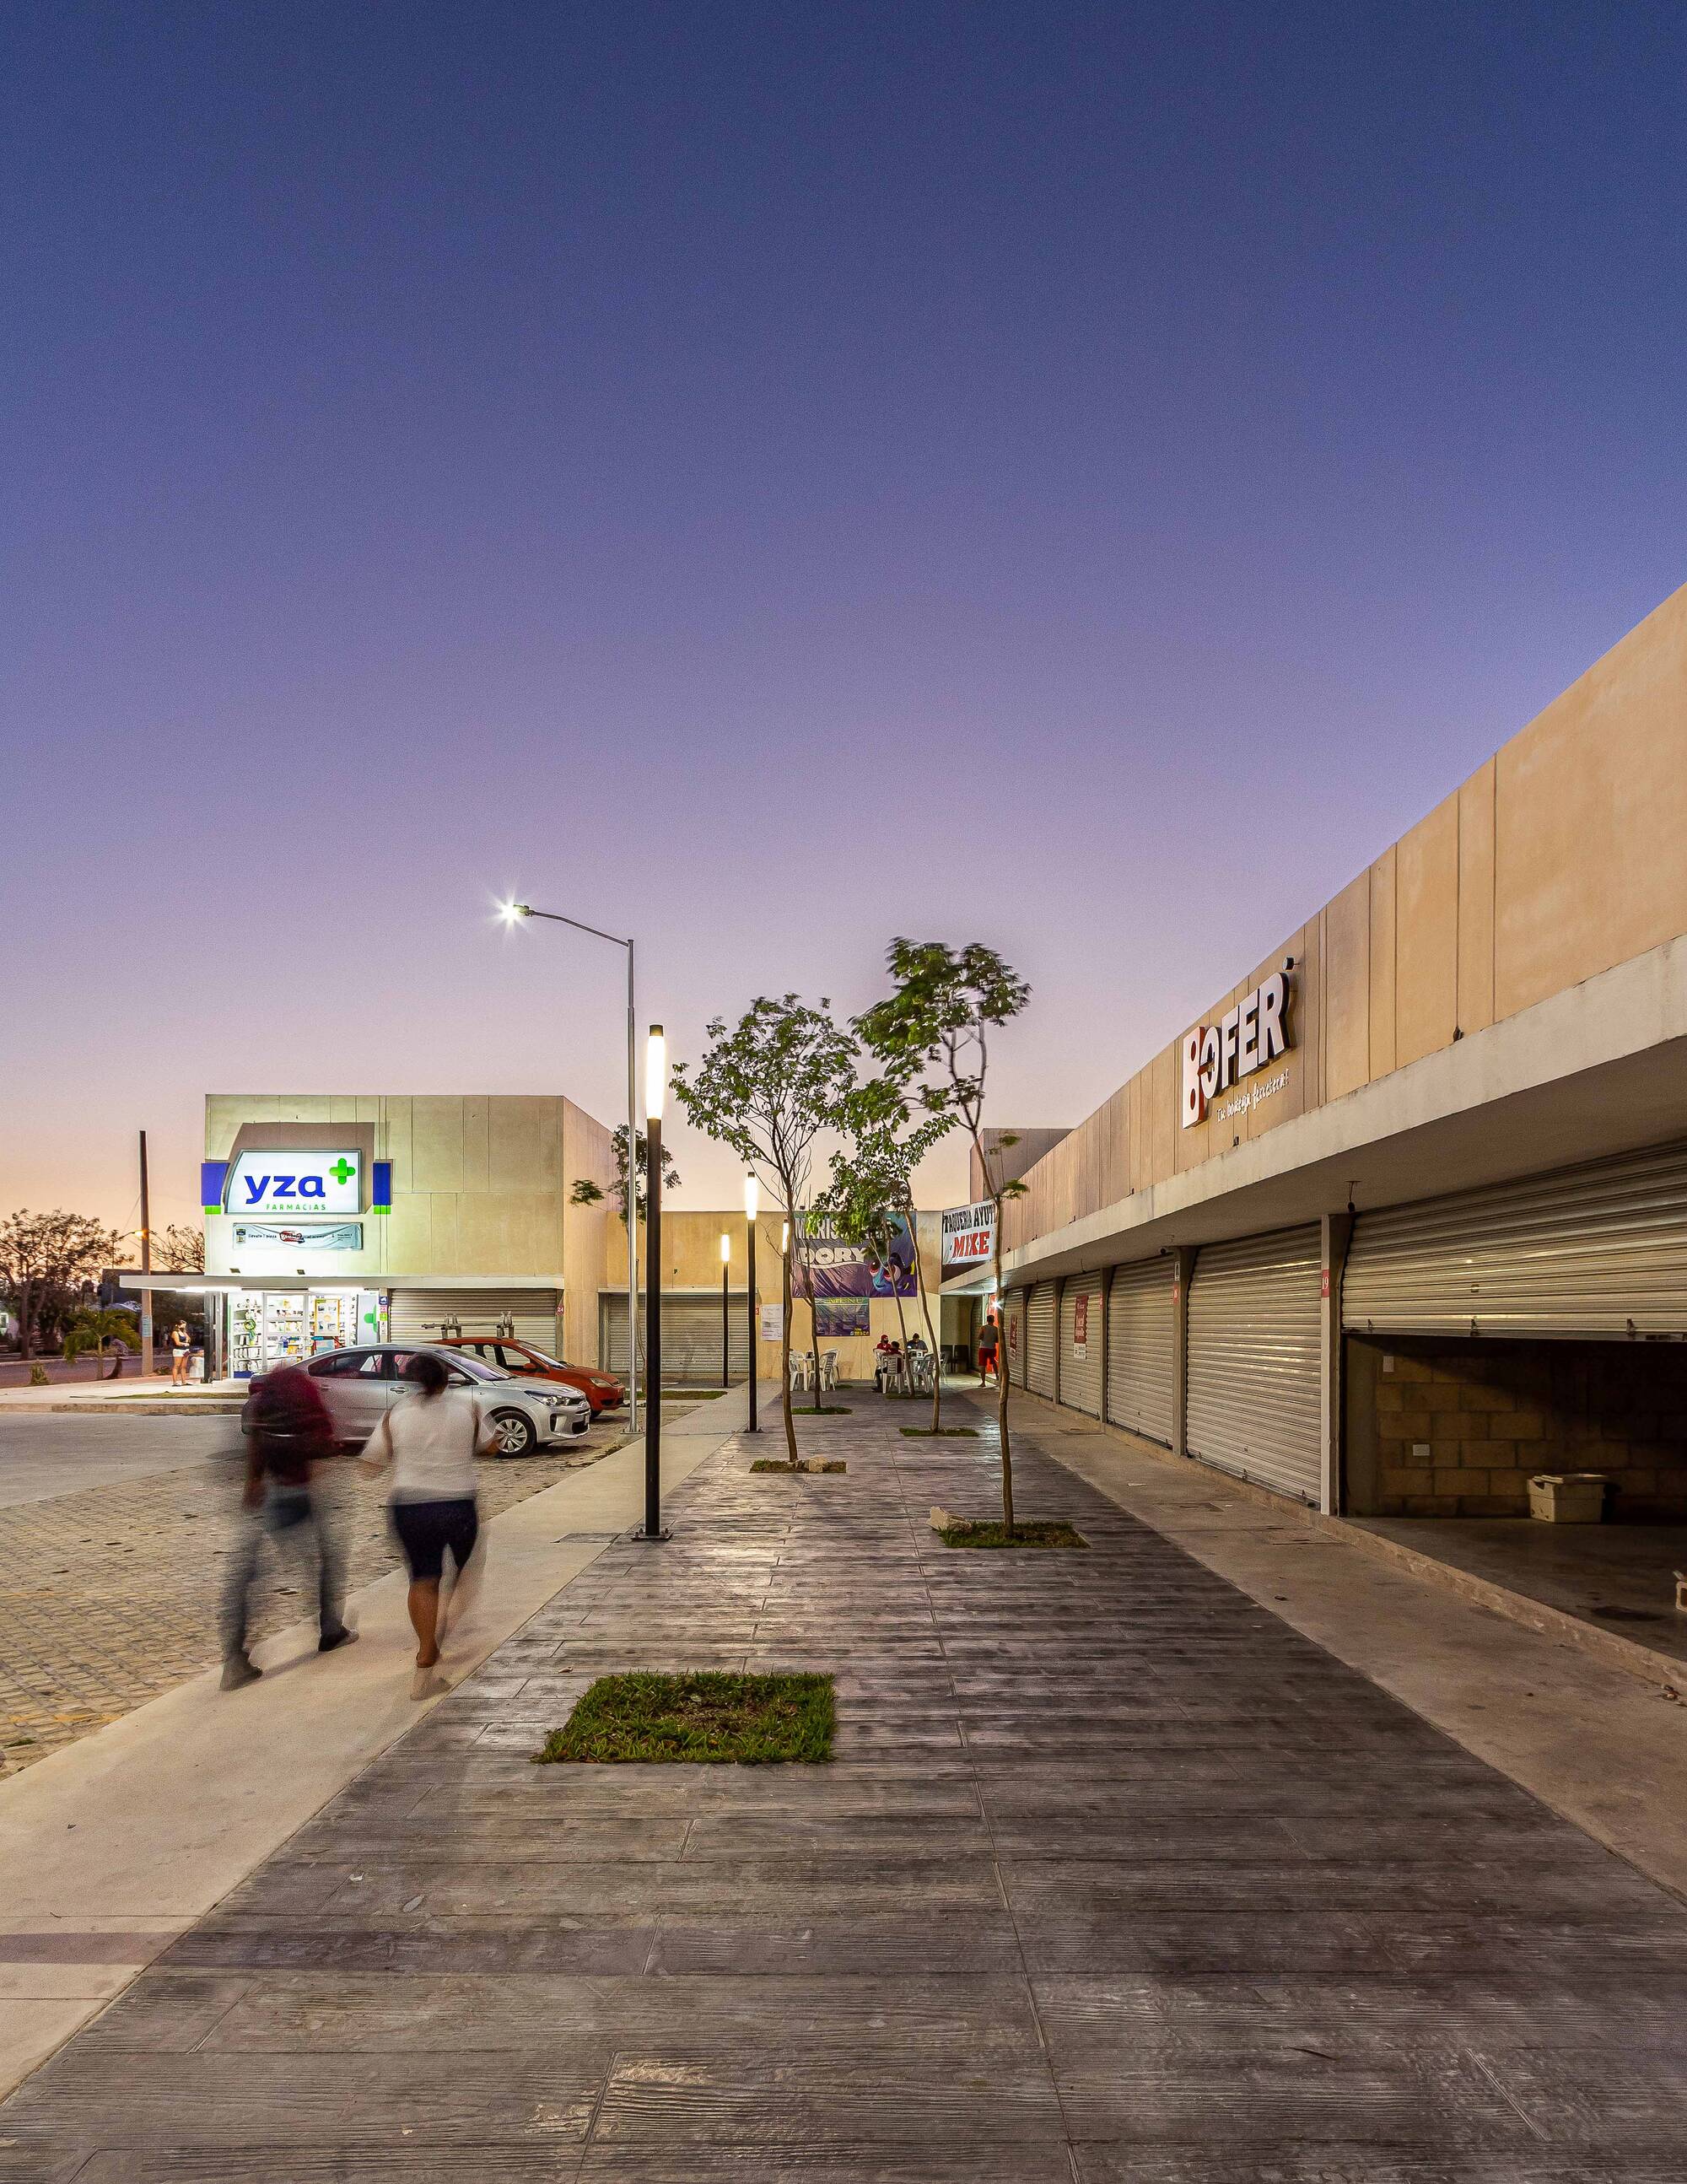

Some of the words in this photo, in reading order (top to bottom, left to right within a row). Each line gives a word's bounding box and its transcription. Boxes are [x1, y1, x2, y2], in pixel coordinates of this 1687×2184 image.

[1183, 972, 1288, 1129] BOFER
[244, 1175, 326, 1205] yza
[798, 1247, 867, 1265] DORY
[952, 1231, 990, 1258] MIKE
[1322, 1276, 1329, 1290] 19
